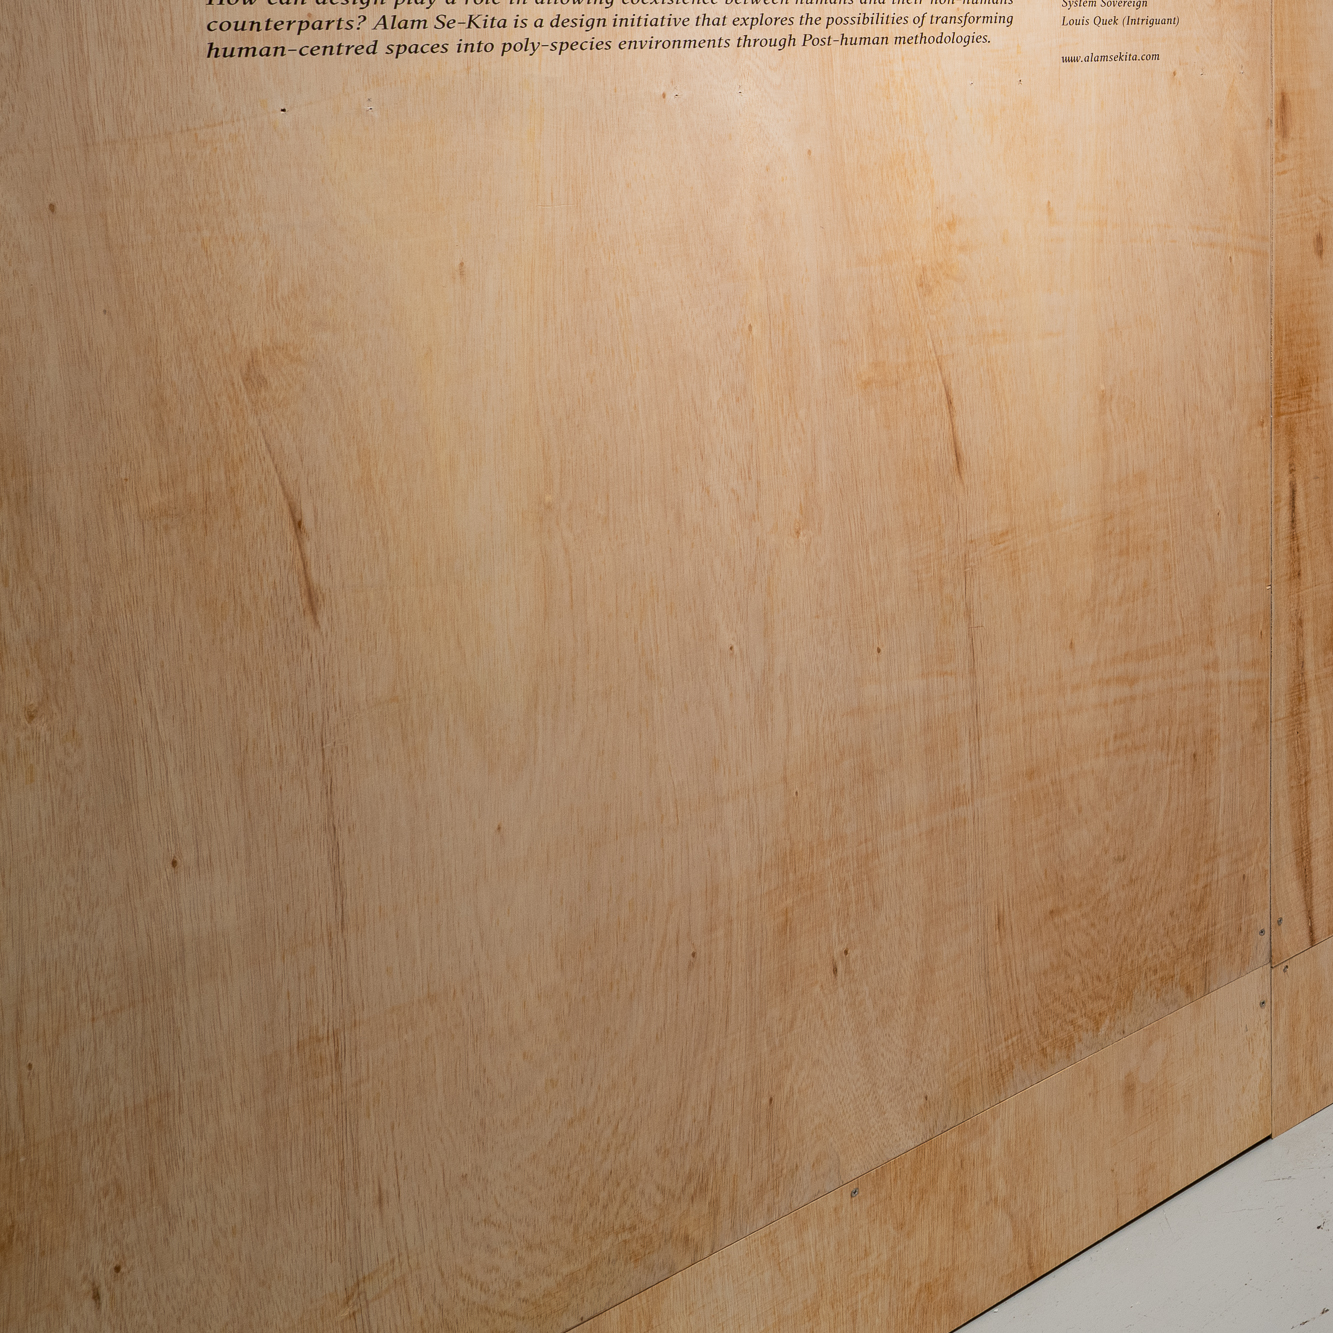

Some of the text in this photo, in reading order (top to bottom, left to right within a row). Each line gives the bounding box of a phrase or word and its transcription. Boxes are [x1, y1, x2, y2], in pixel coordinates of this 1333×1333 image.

[1062, 16, 1090, 26] Louis
[1093, 16, 1119, 27] Quek
[207, 32, 991, 59] human-centred spaces into poly-species environments through Post-human methodologies.
